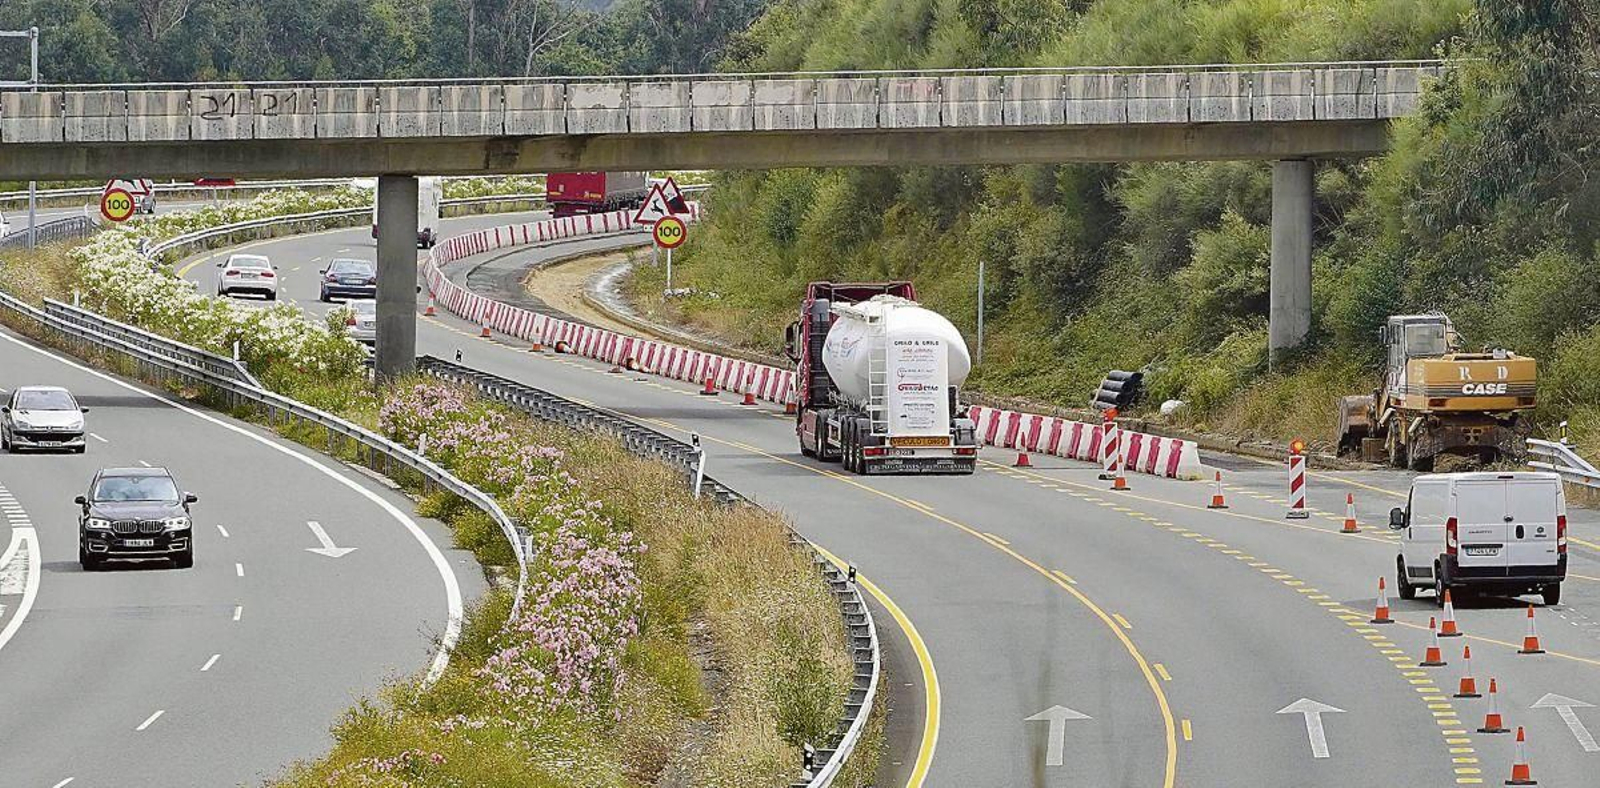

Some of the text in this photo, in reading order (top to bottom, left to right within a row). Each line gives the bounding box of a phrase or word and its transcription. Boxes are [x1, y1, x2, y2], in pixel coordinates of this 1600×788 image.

[107, 199, 130, 210] 100
[659, 226, 681, 238] 100
[1461, 383, 1508, 395] CASE
